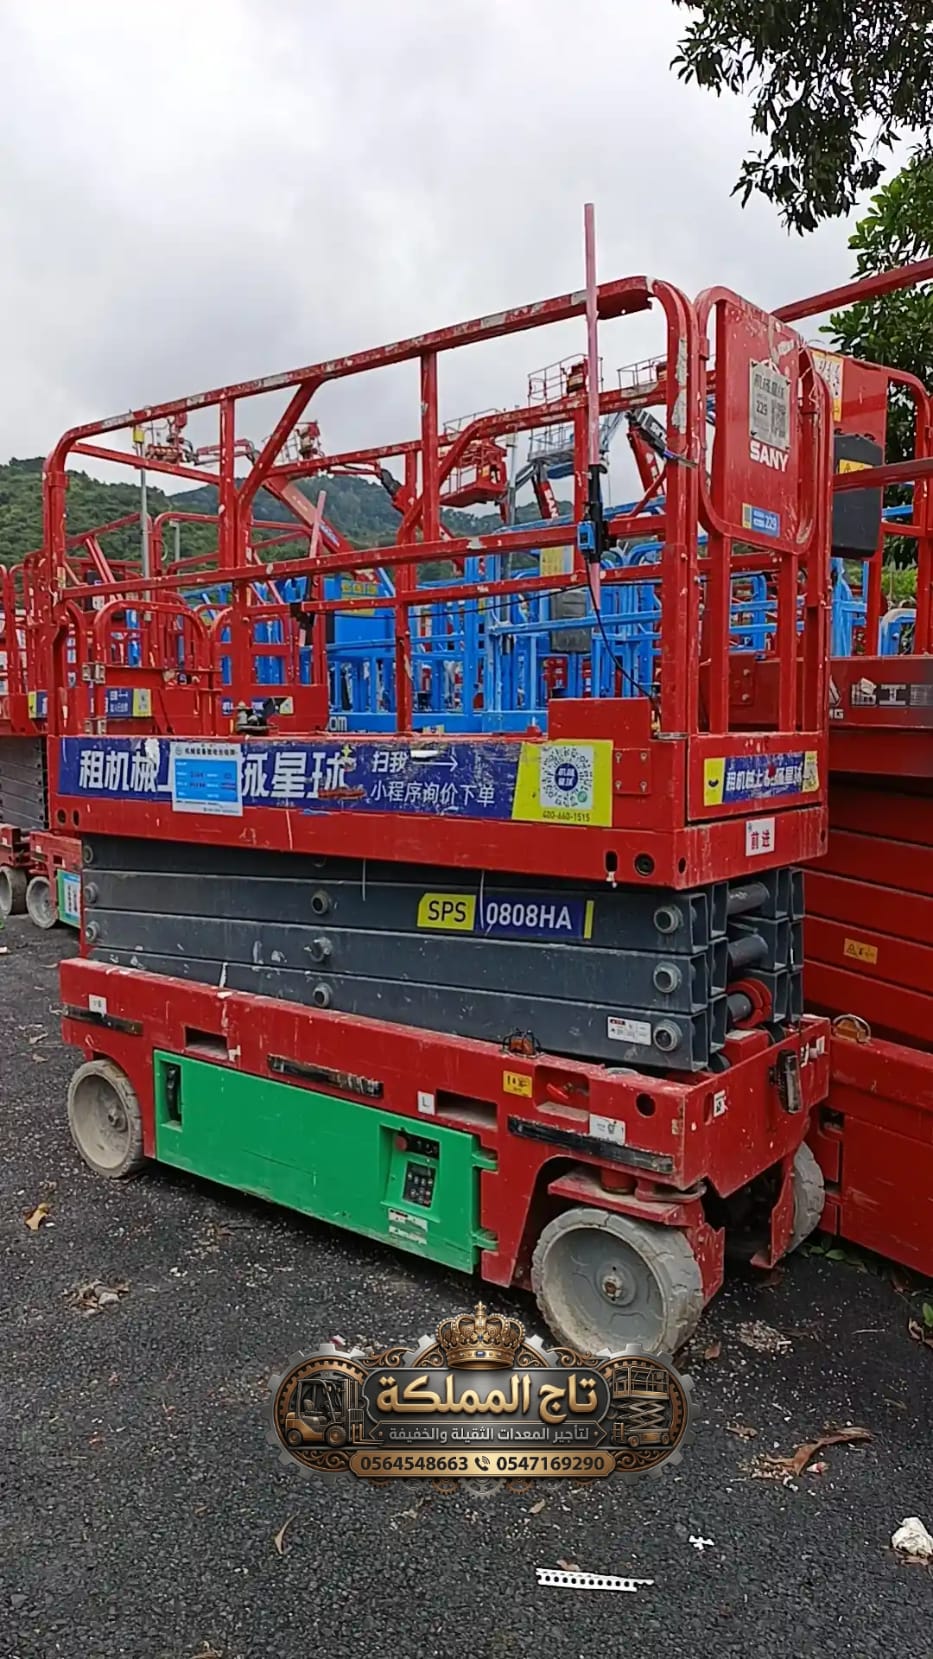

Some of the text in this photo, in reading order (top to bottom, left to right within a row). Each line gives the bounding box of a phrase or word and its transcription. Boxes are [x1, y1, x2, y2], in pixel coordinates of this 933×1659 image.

[750, 440, 789, 473] SANY
[372, 750, 408, 773] 扫我
[370, 778, 497, 808] 小程序询价下单
[427, 900, 572, 930] SPS 0808HA
